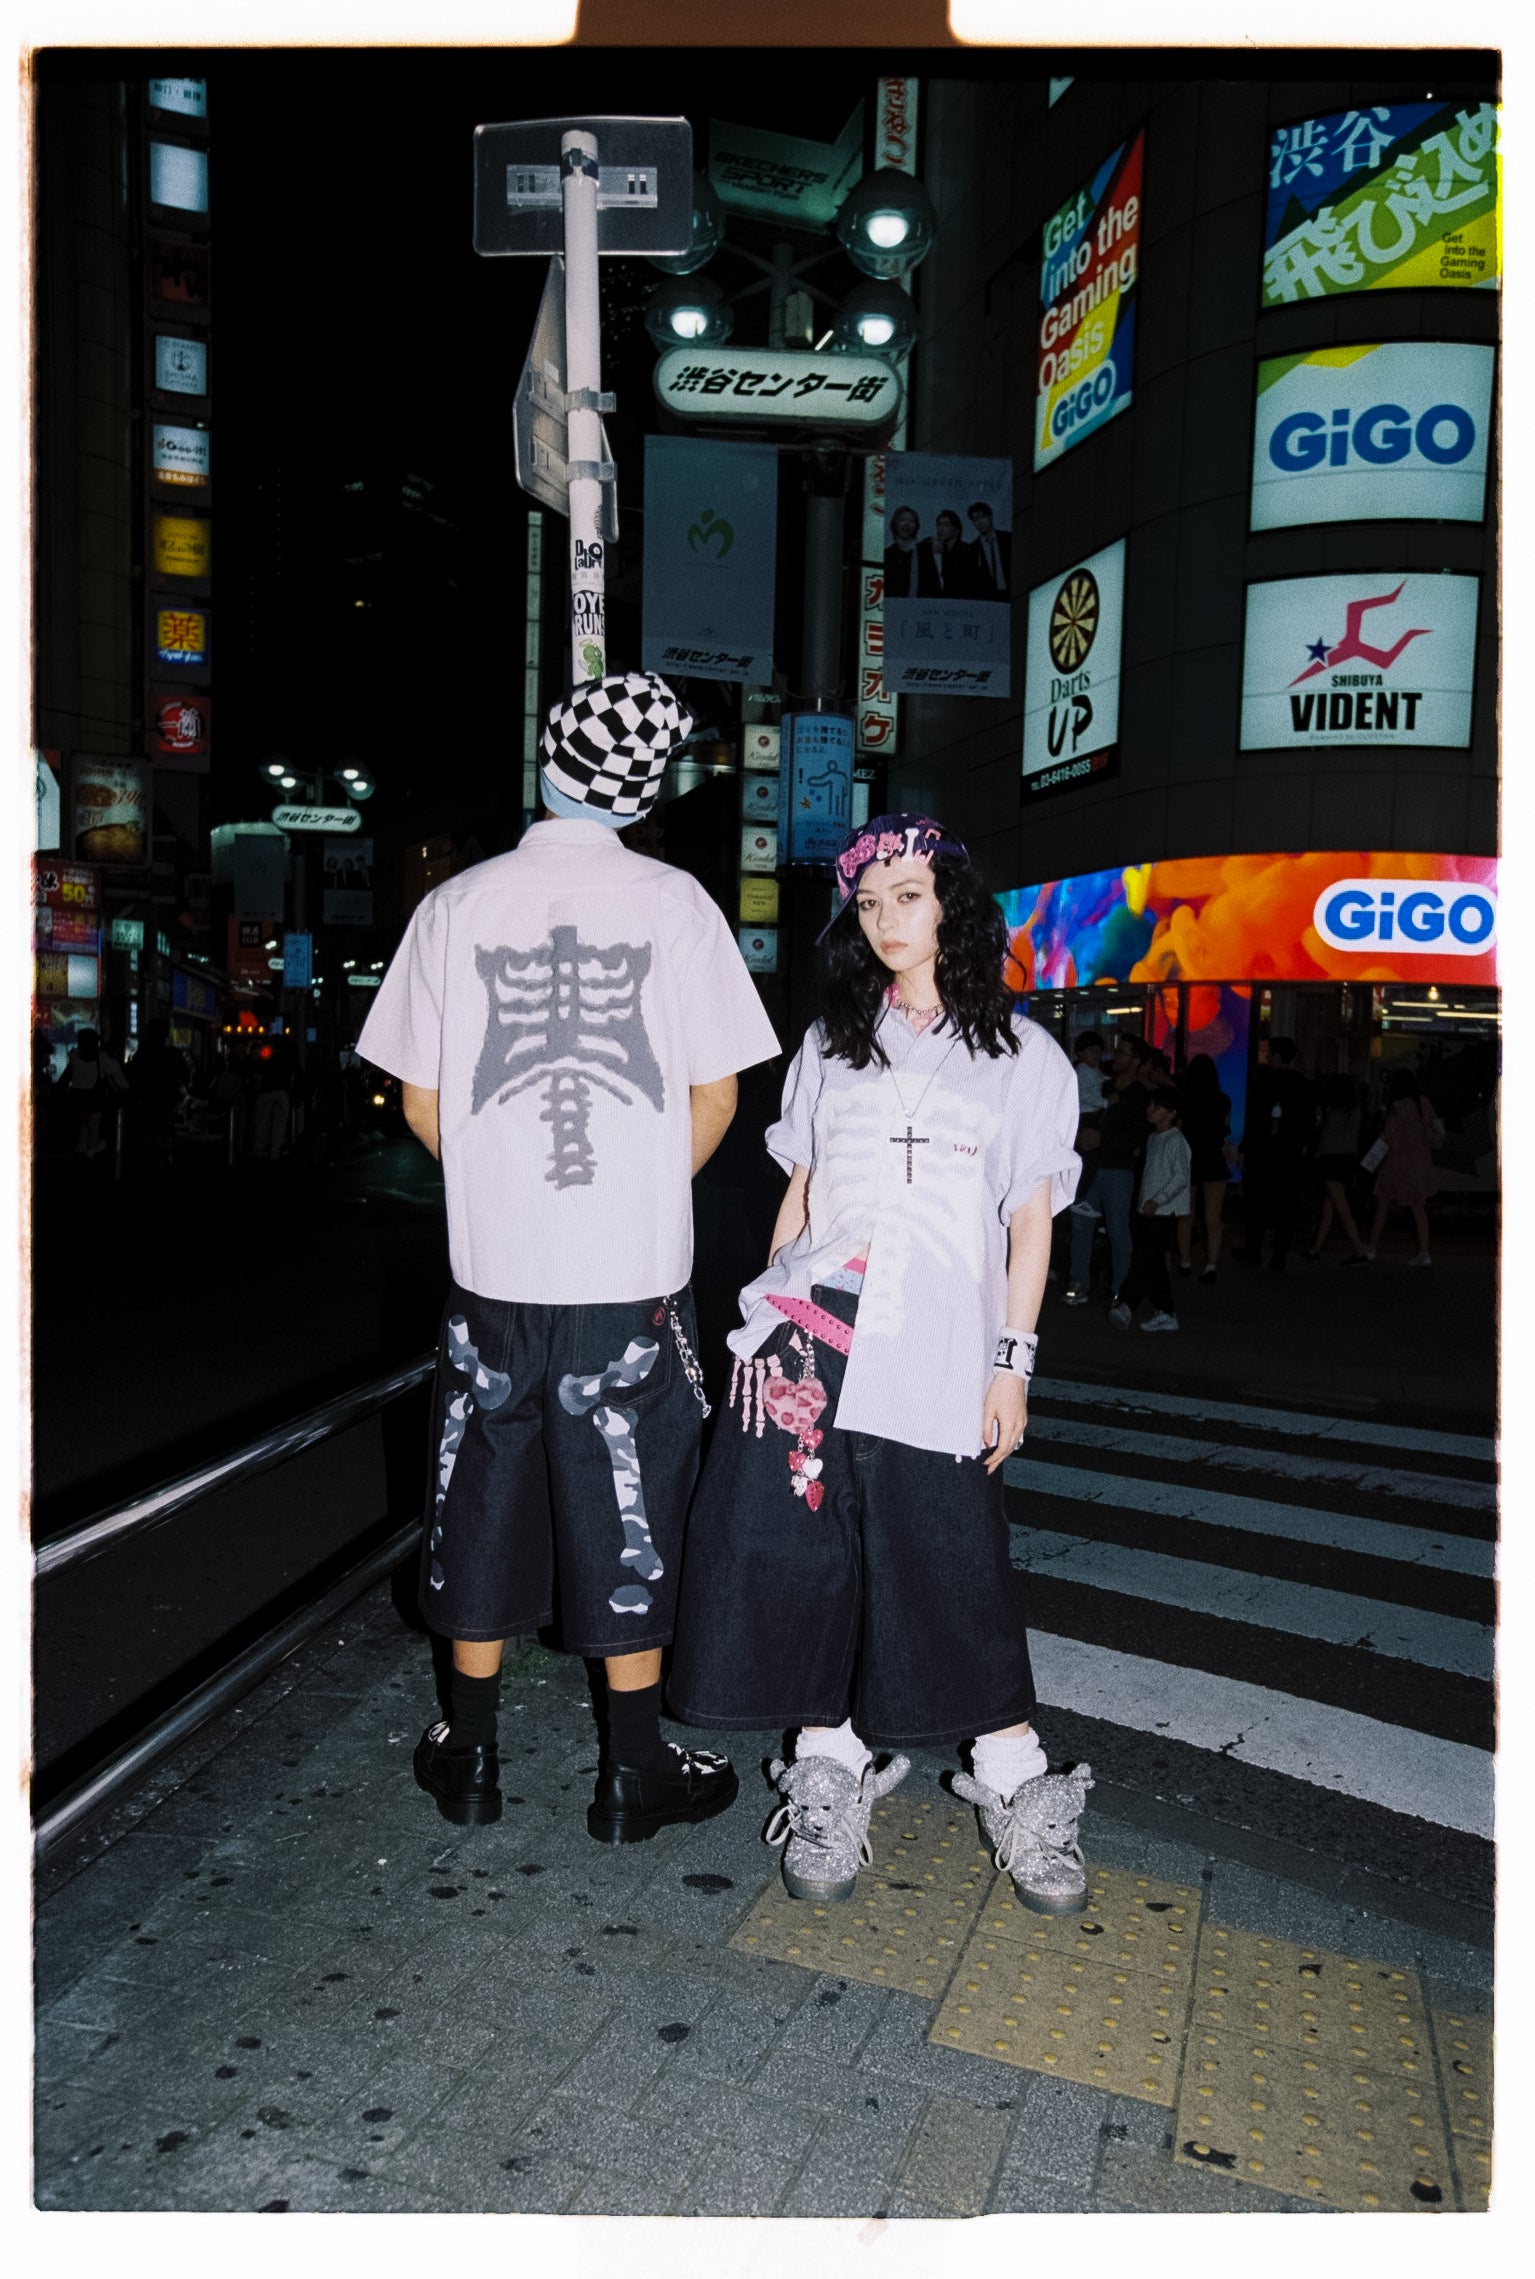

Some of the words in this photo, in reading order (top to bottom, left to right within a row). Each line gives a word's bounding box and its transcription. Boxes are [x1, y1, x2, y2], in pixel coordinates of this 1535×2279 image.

[1270, 106, 1396, 190] 渋谷
[714, 151, 830, 184] SKECHERS
[719, 166, 813, 194] SPORT
[1043, 195, 1087, 257] Get
[1441, 232, 1463, 244] Get
[1047, 245, 1090, 300] into
[1097, 195, 1141, 250] the
[1440, 257, 1486, 272] Gaming
[1444, 245, 1466, 257] into
[1468, 246, 1486, 257] the
[1440, 268, 1472, 280] Oasis
[1040, 244, 1137, 350] Gaming
[1038, 319, 1104, 397] Oasis
[669, 366, 888, 403] 渋谷センター街
[1051, 366, 1116, 438] GiGO
[1269, 403, 1476, 472] GiGO
[164, 613, 199, 650] 薬
[661, 647, 755, 669] 渋谷センター街
[901, 667, 994, 683] 渋谷センター街
[1050, 671, 1092, 701] Darts
[1331, 674, 1384, 687] SHIBUYA
[1047, 695, 1093, 757] UP
[1290, 691, 1423, 732] VIDENT
[1324, 890, 1496, 945] GiGO
